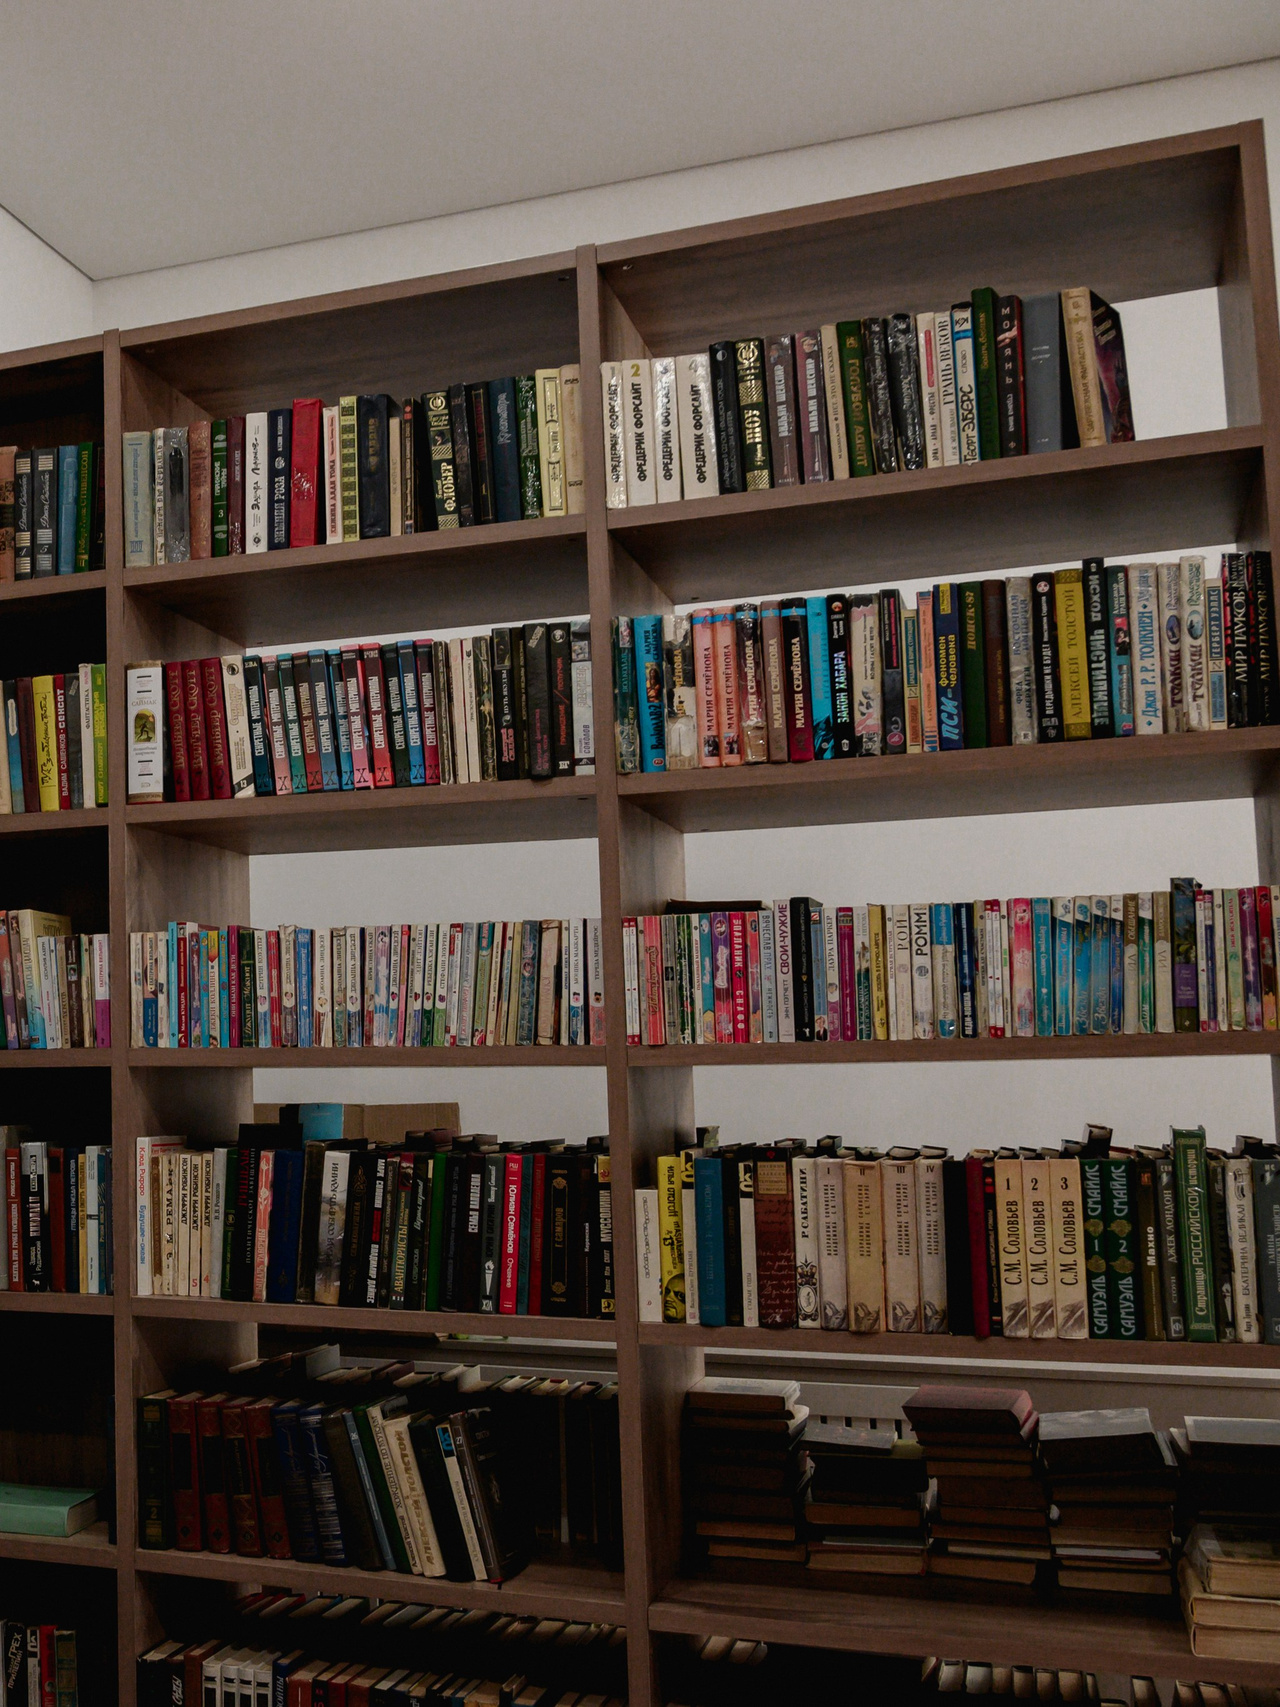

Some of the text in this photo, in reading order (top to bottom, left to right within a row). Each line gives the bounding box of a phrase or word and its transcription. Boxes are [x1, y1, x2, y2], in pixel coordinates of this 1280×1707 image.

[937, 319, 954, 407] ГРАНЬ ВЕКОВ
[629, 382, 647, 482] ФРЕДЕРИК ФОРСАЙТ
[660, 429, 673, 481] ФРЕДЕРИК
[688, 383, 707, 483] ФРЕДЕРИК ФОРСАЙТ
[744, 409, 762, 445] ШОУ
[938, 635, 949, 688] феномен
[947, 634, 958, 688] человека
[1064, 588, 1083, 720] АЛЕКСЕЙ ТОЛСТОЙ
[1088, 574, 1110, 726] ИСХОД ЧИСТИЛИЩЕ
[1210, 620, 1221, 658] ГЕРБЕРТ
[1232, 590, 1248, 683] МИР ПАУКОВ
[299, 682, 316, 754] СЕКРЕТНЫЕ МАТЕРИАЛЫ
[702, 646, 714, 732] МАРИЯ СЕМЁНОВА
[722, 643, 735, 730] МАРИЯ СЕМЁНОВА
[767, 637, 782, 729] МАРИЯ СЕМЁНОВА
[790, 636, 805, 728] МАРИЯ СЕМЁНОВА
[833, 650, 850, 723] ЗАКОН ХАБАРА
[249, 685, 265, 756] СЕКРЕТНЫЕ МАТЕРИАЛЫ
[268, 687, 286, 759] СЕКРЕТНЫЕ МАТЕРИАЛЫ
[284, 685, 302, 757] СЕКРЕТНЫЕ МАТЕРИАЛЫ
[775, 903, 790, 975] СВОИ-ЧУЖИЕ
[913, 911, 928, 956] РОММ
[599, 1189, 613, 1243] МУССОЛИНИ
[798, 1167, 809, 1229] САБАТИНИ
[1029, 1199, 1047, 1255] Соловьев
[1058, 1199, 1077, 1255] Соловьев
[1163, 1189, 1176, 1232] ЛОНДОН
[1186, 1187, 1204, 1266] РОССИЙСКОЙ
[393, 1225, 408, 1293] АВАНТЮРИСТЫ
[1002, 1199, 1023, 1286] С.М. Соловьев
[1030, 1258, 1048, 1286] С.М.
[1059, 1258, 1078, 1287] С.М.
[1084, 1164, 1109, 1335] САМУЭЛЬ СМАЙЛС
[1110, 1164, 1136, 1336] САМУЭЛЬ СМАЙЛС
[1145, 1226, 1156, 1266] Махно
[1166, 1233, 1178, 1263] ДЖЕК
[1236, 1204, 1250, 1296] ЕКАТЕРИНА ВЕЛИКАЯ
